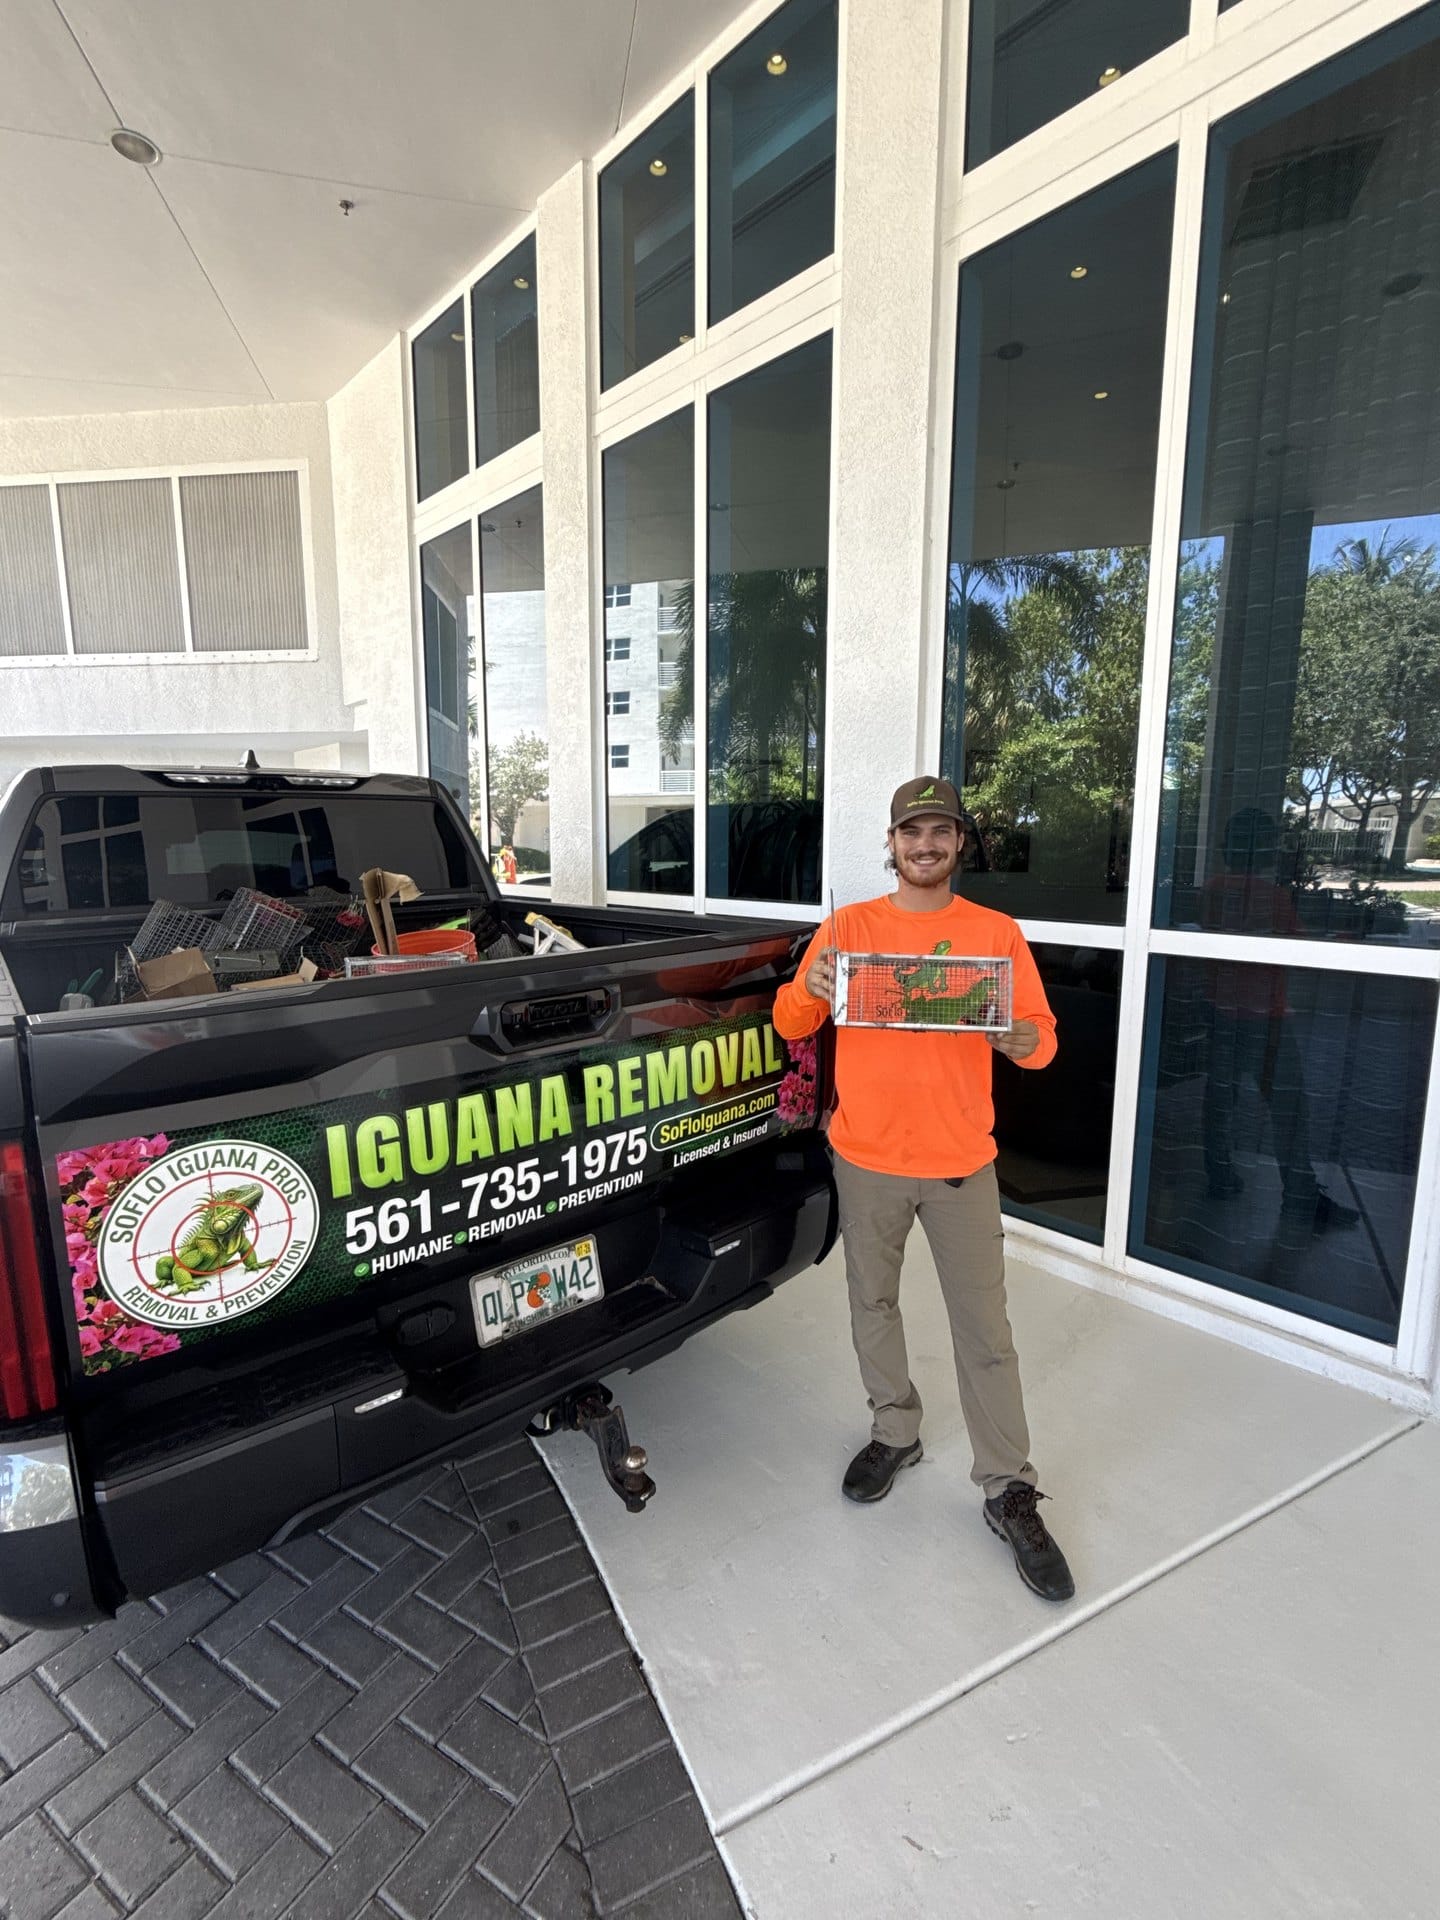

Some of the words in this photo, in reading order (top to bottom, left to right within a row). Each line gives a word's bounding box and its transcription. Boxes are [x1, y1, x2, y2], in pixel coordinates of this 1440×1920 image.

[326, 1074, 573, 1199] IGUANA
[583, 1023, 782, 1128] REMOVAL
[660, 1093, 775, 1144] SoFloIguana.com
[673, 1140, 720, 1167] Licensed
[722, 1136, 731, 1149] &
[733, 1121, 768, 1145] Insured
[110, 1176, 166, 1244] SOFLO
[166, 1149, 257, 1183] IGUANA
[261, 1158, 306, 1206] PROS
[345, 1126, 648, 1255] 561-735-1975
[371, 1234, 453, 1275] HUMANE
[468, 1208, 545, 1243] REMOVAL
[558, 1170, 644, 1212] PREVENTION
[122, 1285, 199, 1322] REMOVAL
[205, 1303, 218, 1318] &
[224, 1239, 307, 1314] PREVENTION
